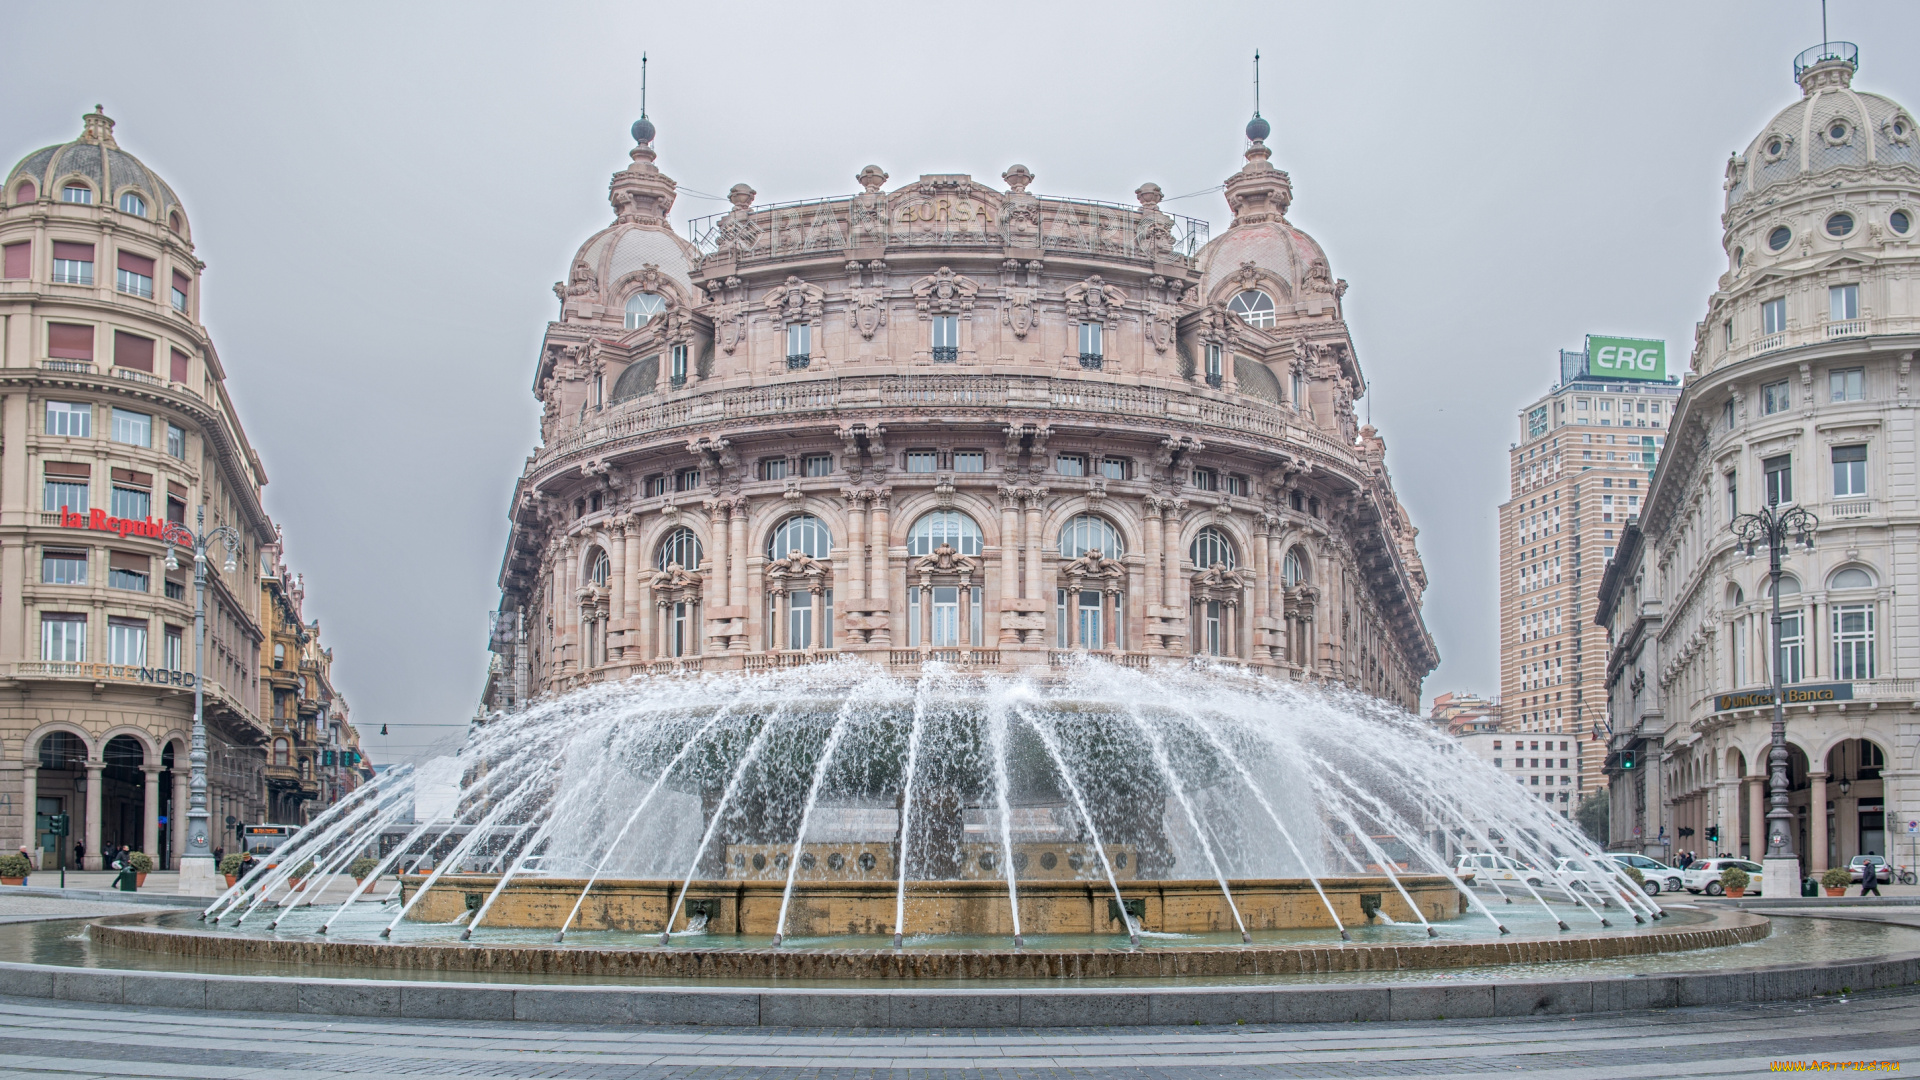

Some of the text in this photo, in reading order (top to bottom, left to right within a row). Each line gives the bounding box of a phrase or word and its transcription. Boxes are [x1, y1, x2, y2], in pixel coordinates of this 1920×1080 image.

[898, 199, 993, 222] BORSA
[1597, 345, 1658, 371] ERG
[61, 505, 83, 528] la
[1788, 689, 1834, 702] Banca
